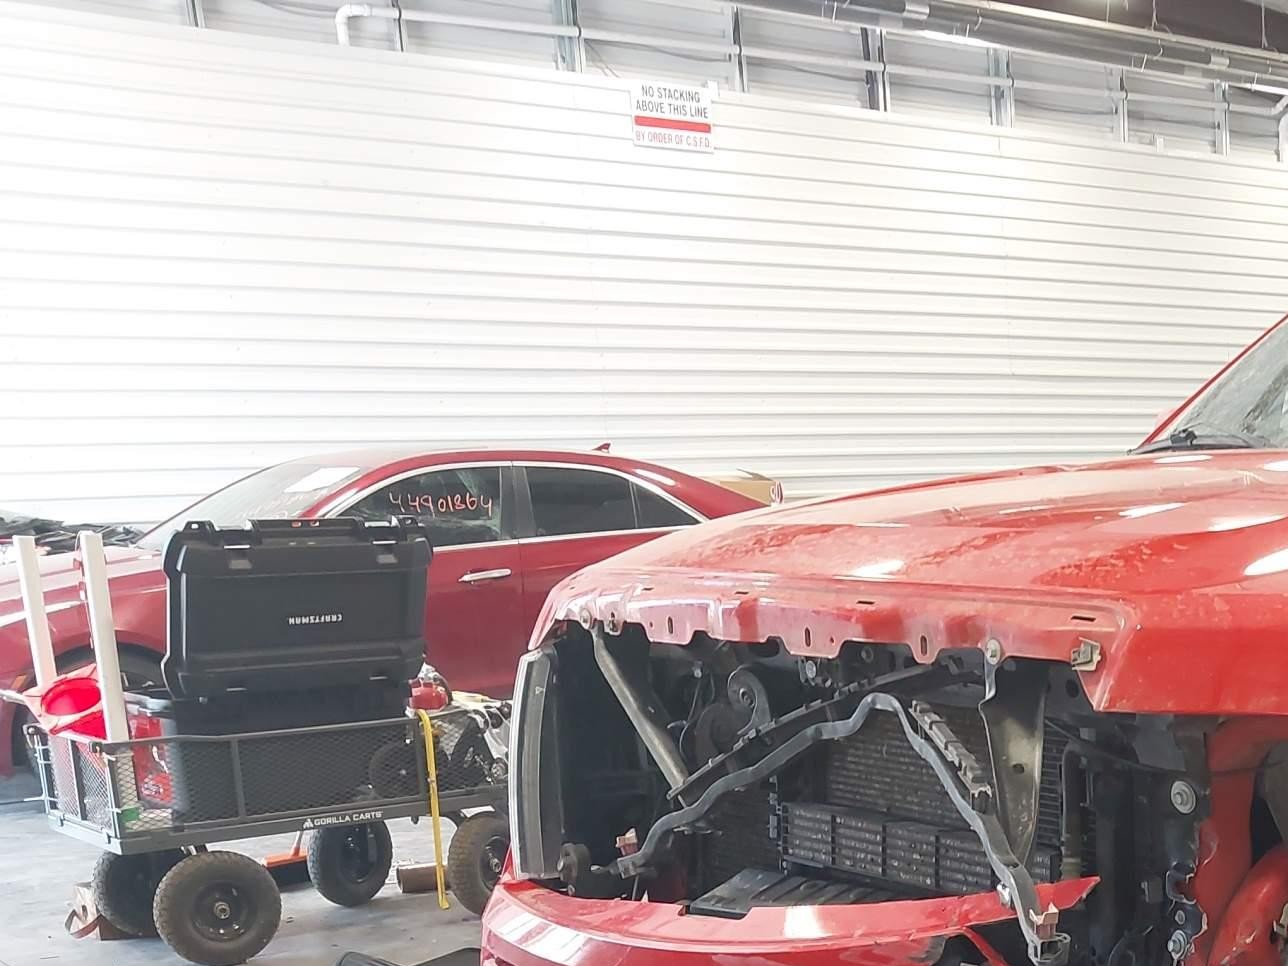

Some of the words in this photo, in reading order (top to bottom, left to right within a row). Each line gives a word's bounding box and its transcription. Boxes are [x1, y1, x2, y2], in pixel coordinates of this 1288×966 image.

[641, 84, 655, 98] NO
[657, 86, 701, 104] STACKING
[636, 99, 665, 114] ABOVE
[668, 103, 687, 117] THIS
[689, 105, 709, 119] LINE
[635, 130, 646, 141] BY
[647, 131, 673, 145] ORDER
[674, 134, 684, 145] OF
[389, 491, 493, 518] 44901864
[288, 613, 343, 625] CRAFTSMAN
[314, 815, 351, 826] GORILLA
[353, 812, 382, 821] CARTS
